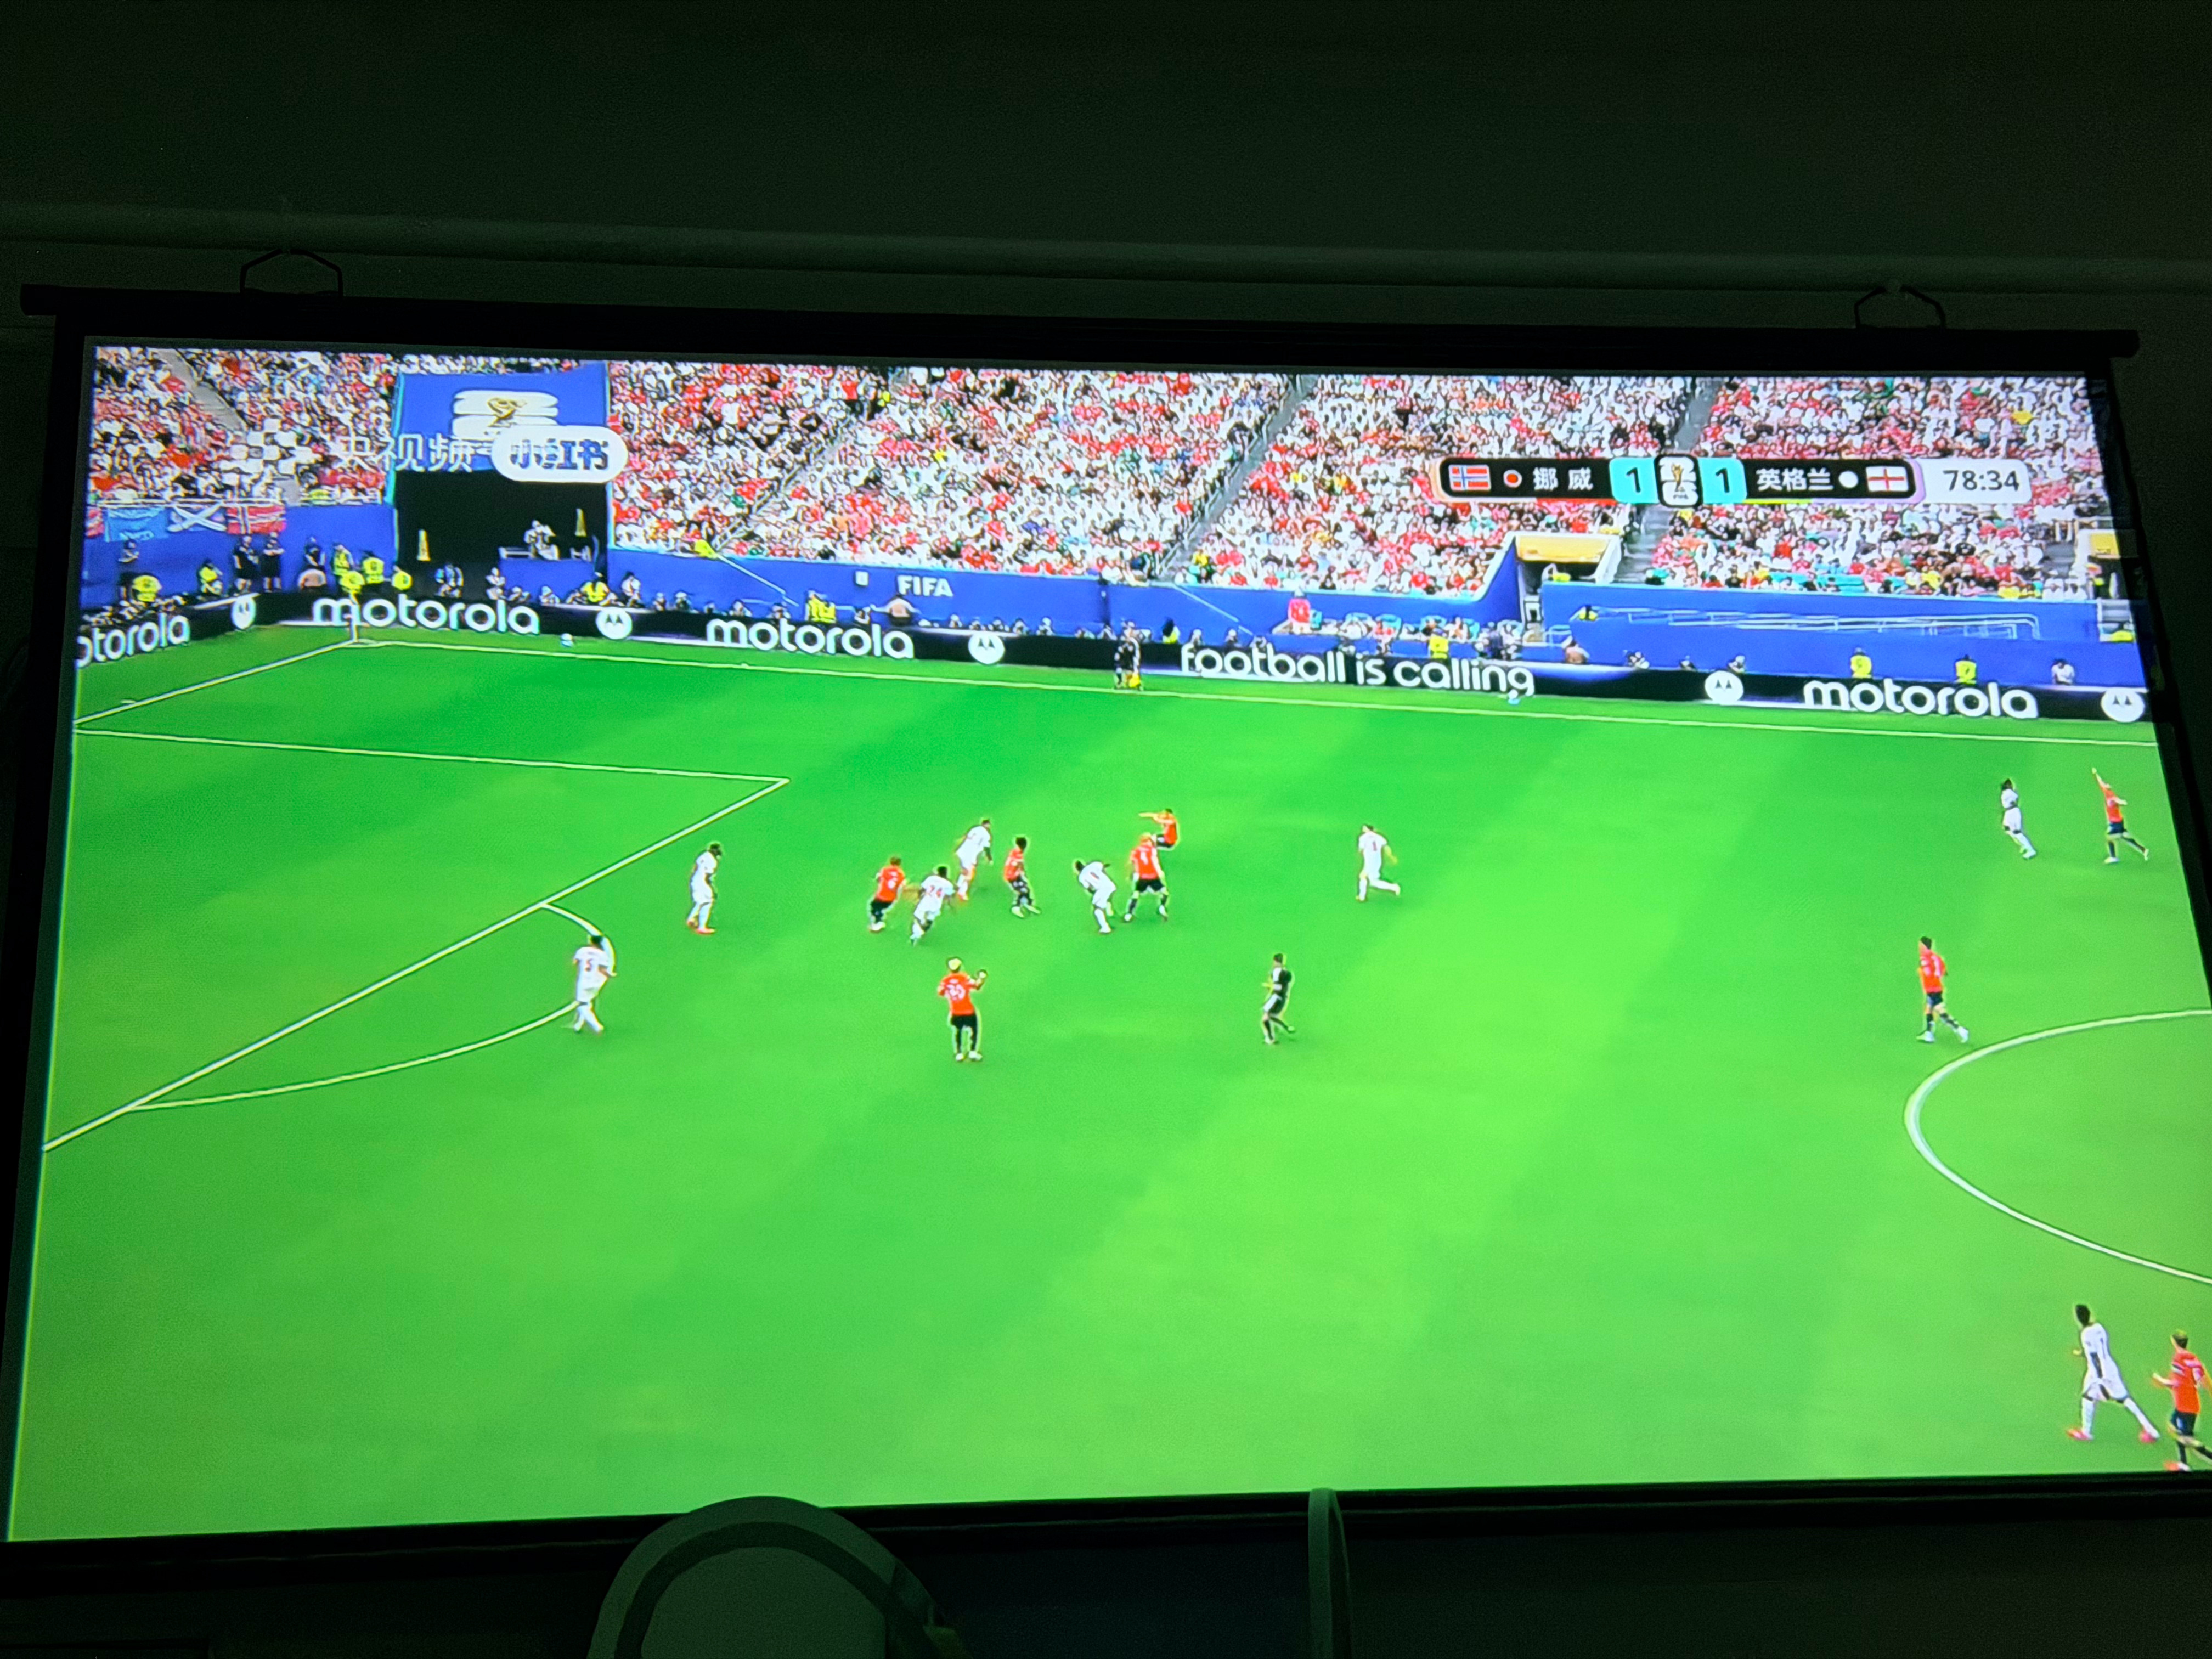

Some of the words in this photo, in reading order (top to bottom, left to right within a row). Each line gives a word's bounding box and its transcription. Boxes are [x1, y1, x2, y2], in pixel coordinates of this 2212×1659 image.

[510, 438, 609, 469] 小红书
[1533, 467, 1593, 490] 挪威
[1626, 467, 1641, 493] 1
[1715, 467, 1730, 493] 1
[1756, 468, 1833, 492] 英格兰
[1943, 470, 2020, 492] 78:34
[897, 574, 954, 597] FIFA
[312, 594, 540, 634] motorola
[706, 619, 913, 658] motorola
[1182, 648, 1345, 682] football
[1356, 653, 1386, 685] is
[1393, 659, 1534, 698] calling
[1804, 679, 2038, 719] motorola
